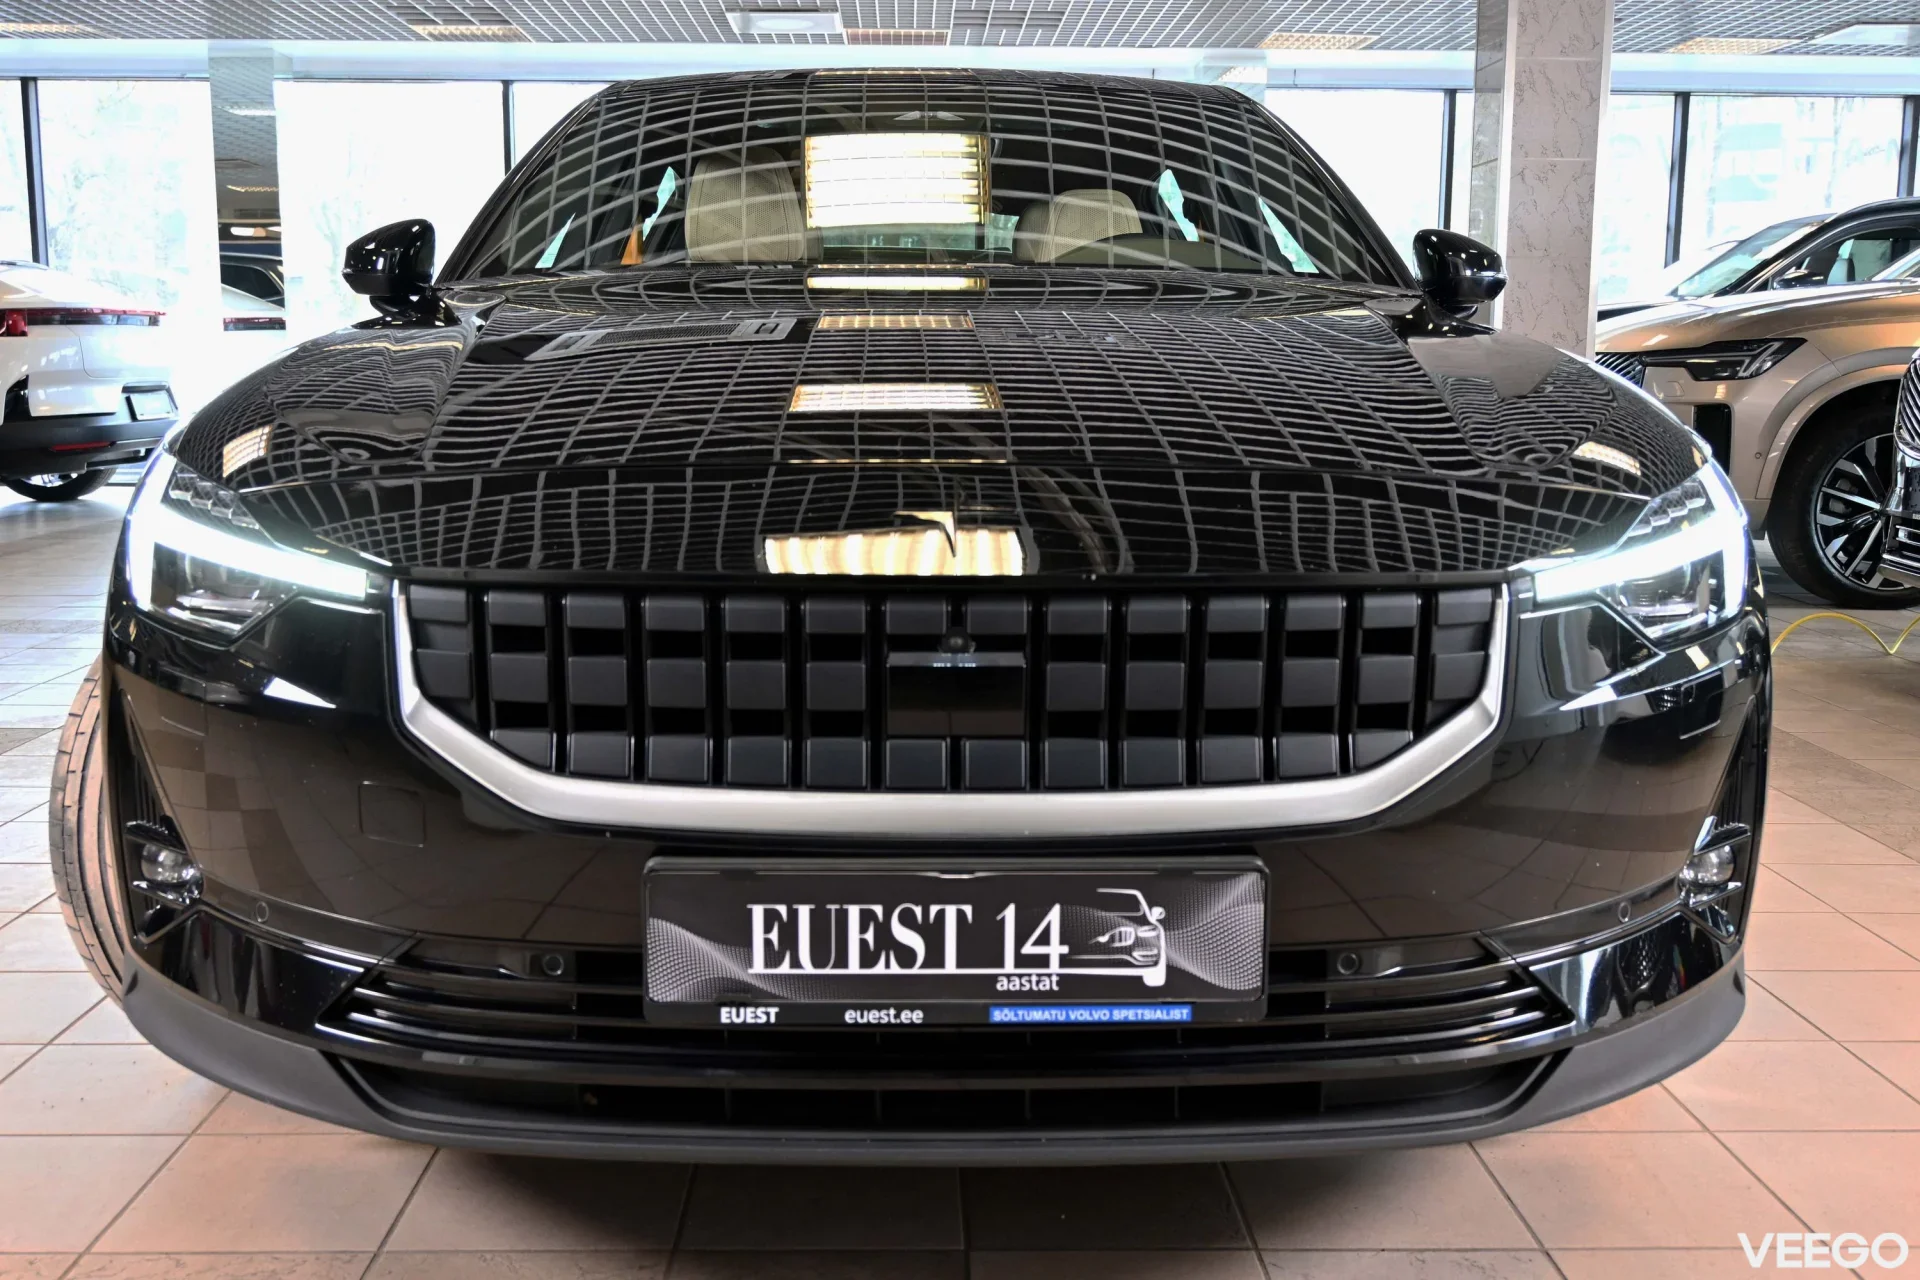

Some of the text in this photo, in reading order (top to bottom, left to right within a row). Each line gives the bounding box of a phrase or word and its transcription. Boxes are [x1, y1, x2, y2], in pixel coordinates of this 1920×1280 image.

[746, 902, 1069, 973] EUEST 14
[996, 973, 1060, 991] aastat
[720, 1006, 780, 1024] EUEST
[844, 1006, 924, 1024] euest.ee
[1068, 1008, 1110, 1021] VOLVO
[1112, 1007, 1190, 1021] SPETSIALIST
